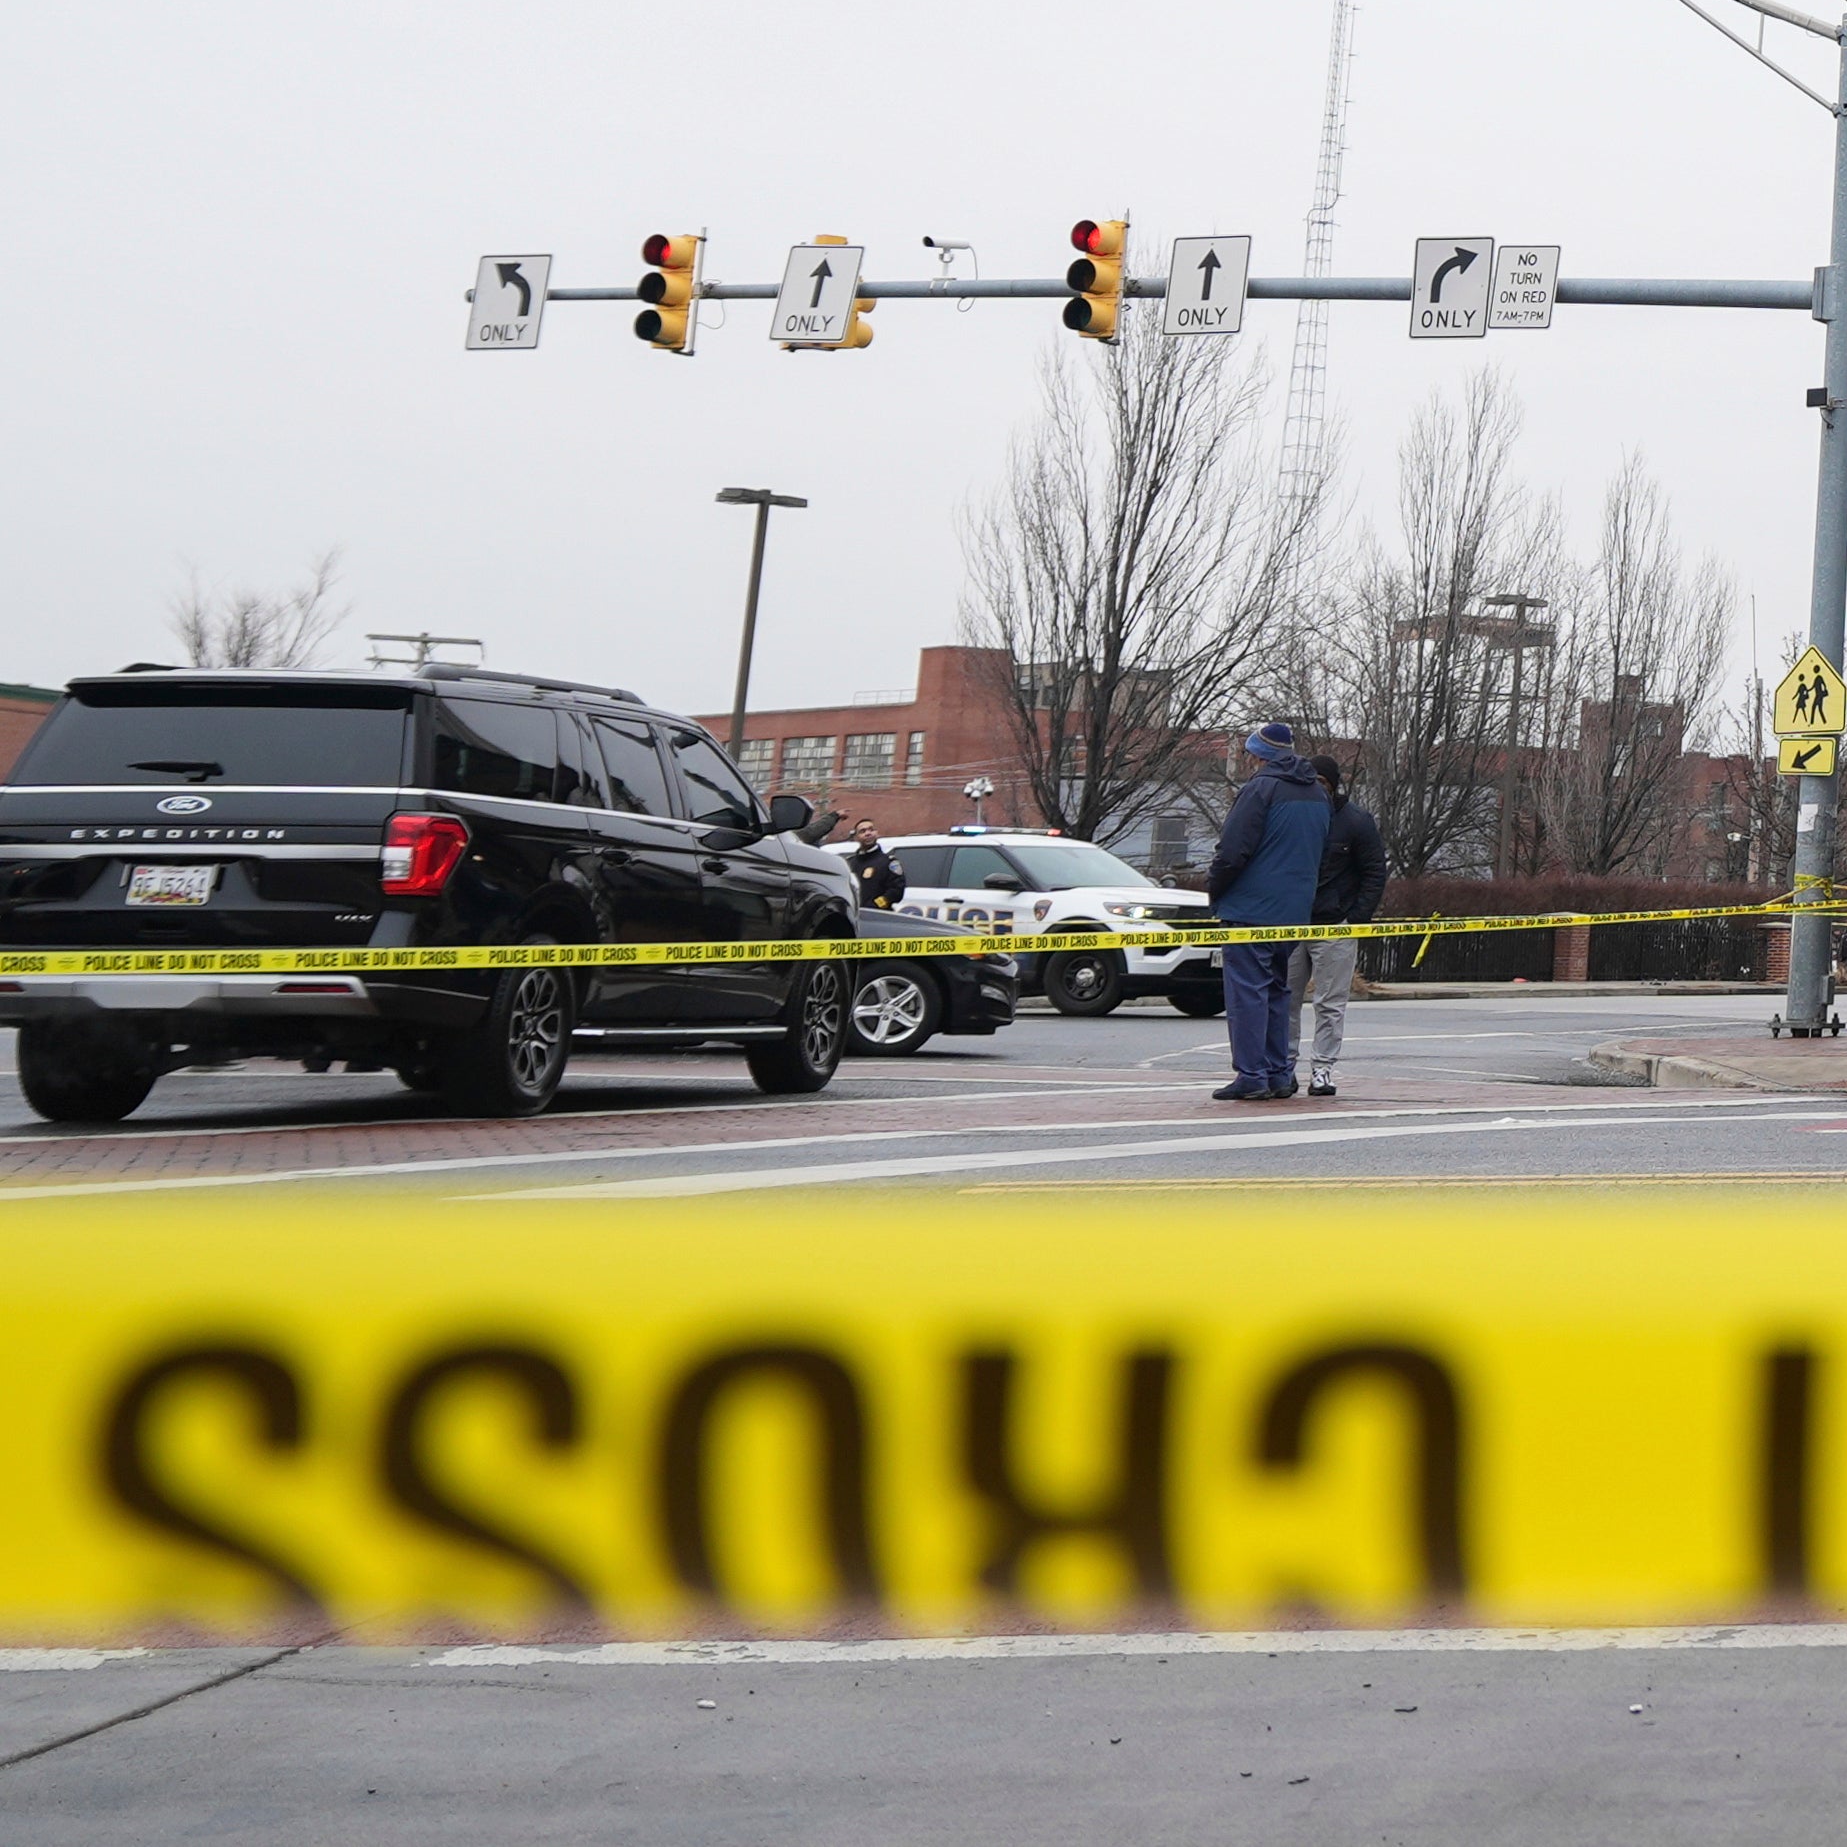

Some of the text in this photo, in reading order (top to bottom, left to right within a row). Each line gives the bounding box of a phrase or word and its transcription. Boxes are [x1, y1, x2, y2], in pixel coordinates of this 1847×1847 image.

[1517, 252, 1538, 266] NO
[1510, 272, 1543, 285] TURN
[1500, 290, 1547, 303] ON RED
[785, 315, 834, 333] ONLY
[1177, 307, 1228, 327] ONLY
[1421, 309, 1477, 328] ONLY
[480, 323, 528, 341] ONLY
[70, 829, 286, 840] EXPEDITION
[980, 935, 1097, 949] POLICE LINE DO NOT CROSS
[1120, 931, 1229, 945] POLICE LINE DO NOT CROSS
[665, 943, 802, 959] POLICE LINE DO NOT CROSS
[828, 939, 955, 954] POLICE LINE DO NOT CROSS
[82, 953, 261, 970] POLICE LINE DO NOT CROSS
[295, 951, 457, 967] POLICE LINE DO NOT CROSS
[488, 947, 636, 963] POLICE LINE DO NOT CROSS
[88, 1329, 1490, 1629] CROSS
